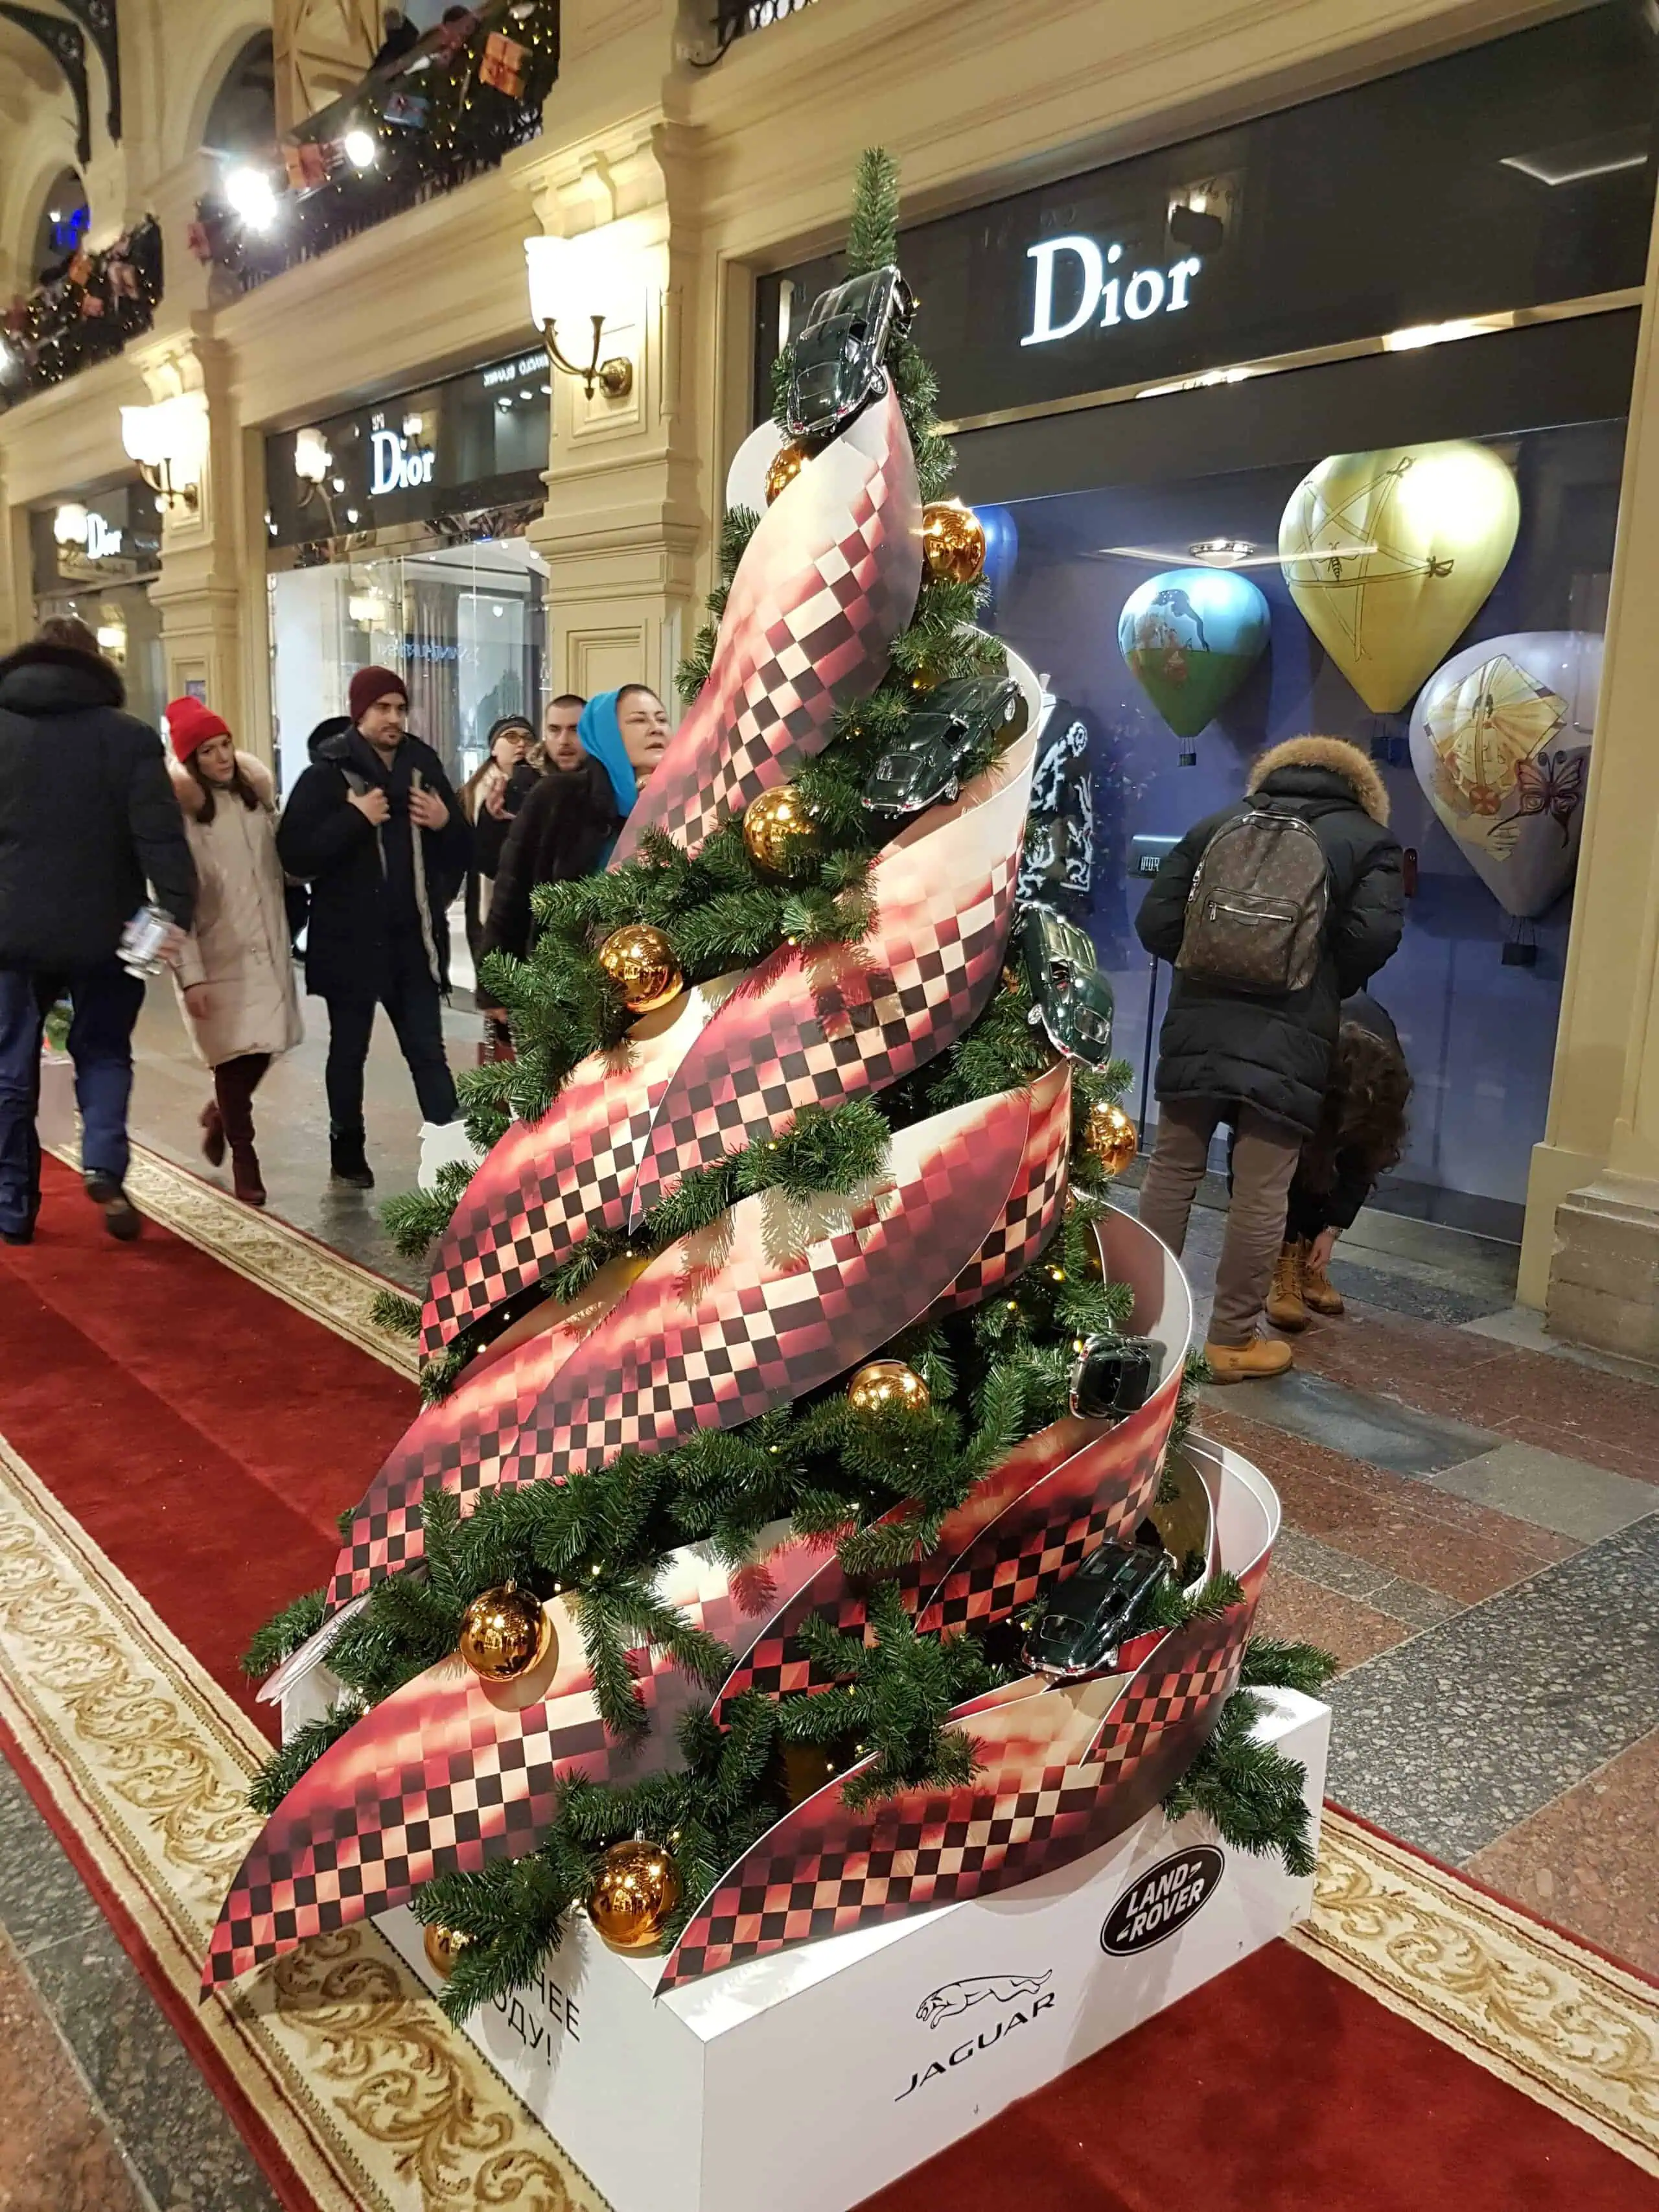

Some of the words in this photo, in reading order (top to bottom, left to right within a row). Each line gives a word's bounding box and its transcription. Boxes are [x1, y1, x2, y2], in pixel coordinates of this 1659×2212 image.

[1020, 235, 1201, 347] Dior
[370, 430, 435, 495] Dior
[87, 513, 122, 559] Dior
[1126, 1863, 1189, 1918] LAND
[1129, 1878, 1205, 1942] ROVER
[493, 1988, 551, 2066] ОДУ!
[529, 1972, 580, 2043] ЧЕЕ
[894, 1992, 1055, 2102] JAGUAR
